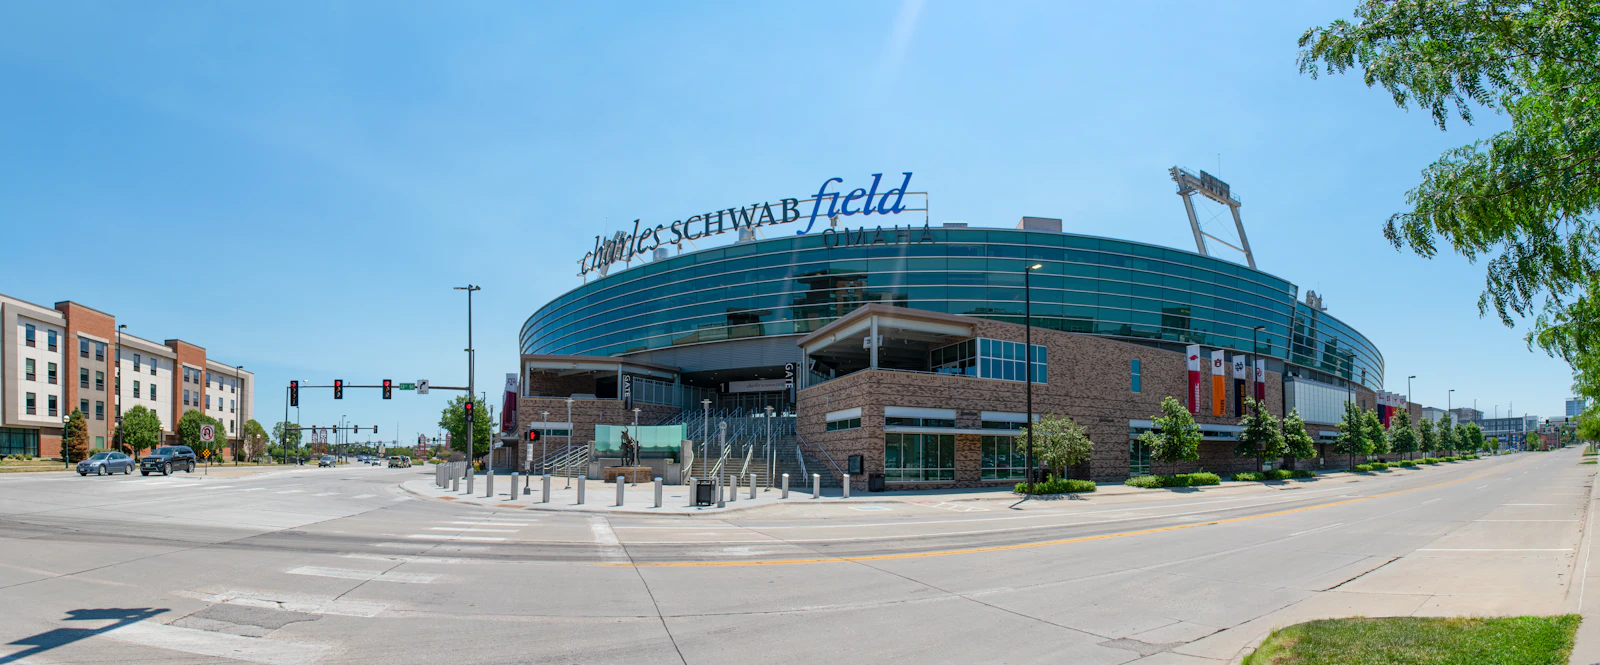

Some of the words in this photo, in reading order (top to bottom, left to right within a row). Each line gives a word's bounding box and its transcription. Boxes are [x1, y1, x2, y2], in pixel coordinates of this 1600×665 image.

[580, 219, 665, 276] charles
[670, 198, 801, 245] SCHWAB
[796, 172, 914, 236] field
[821, 224, 936, 249] OMAHA
[720, 382, 725, 392] 1
[785, 363, 794, 389] GATE
